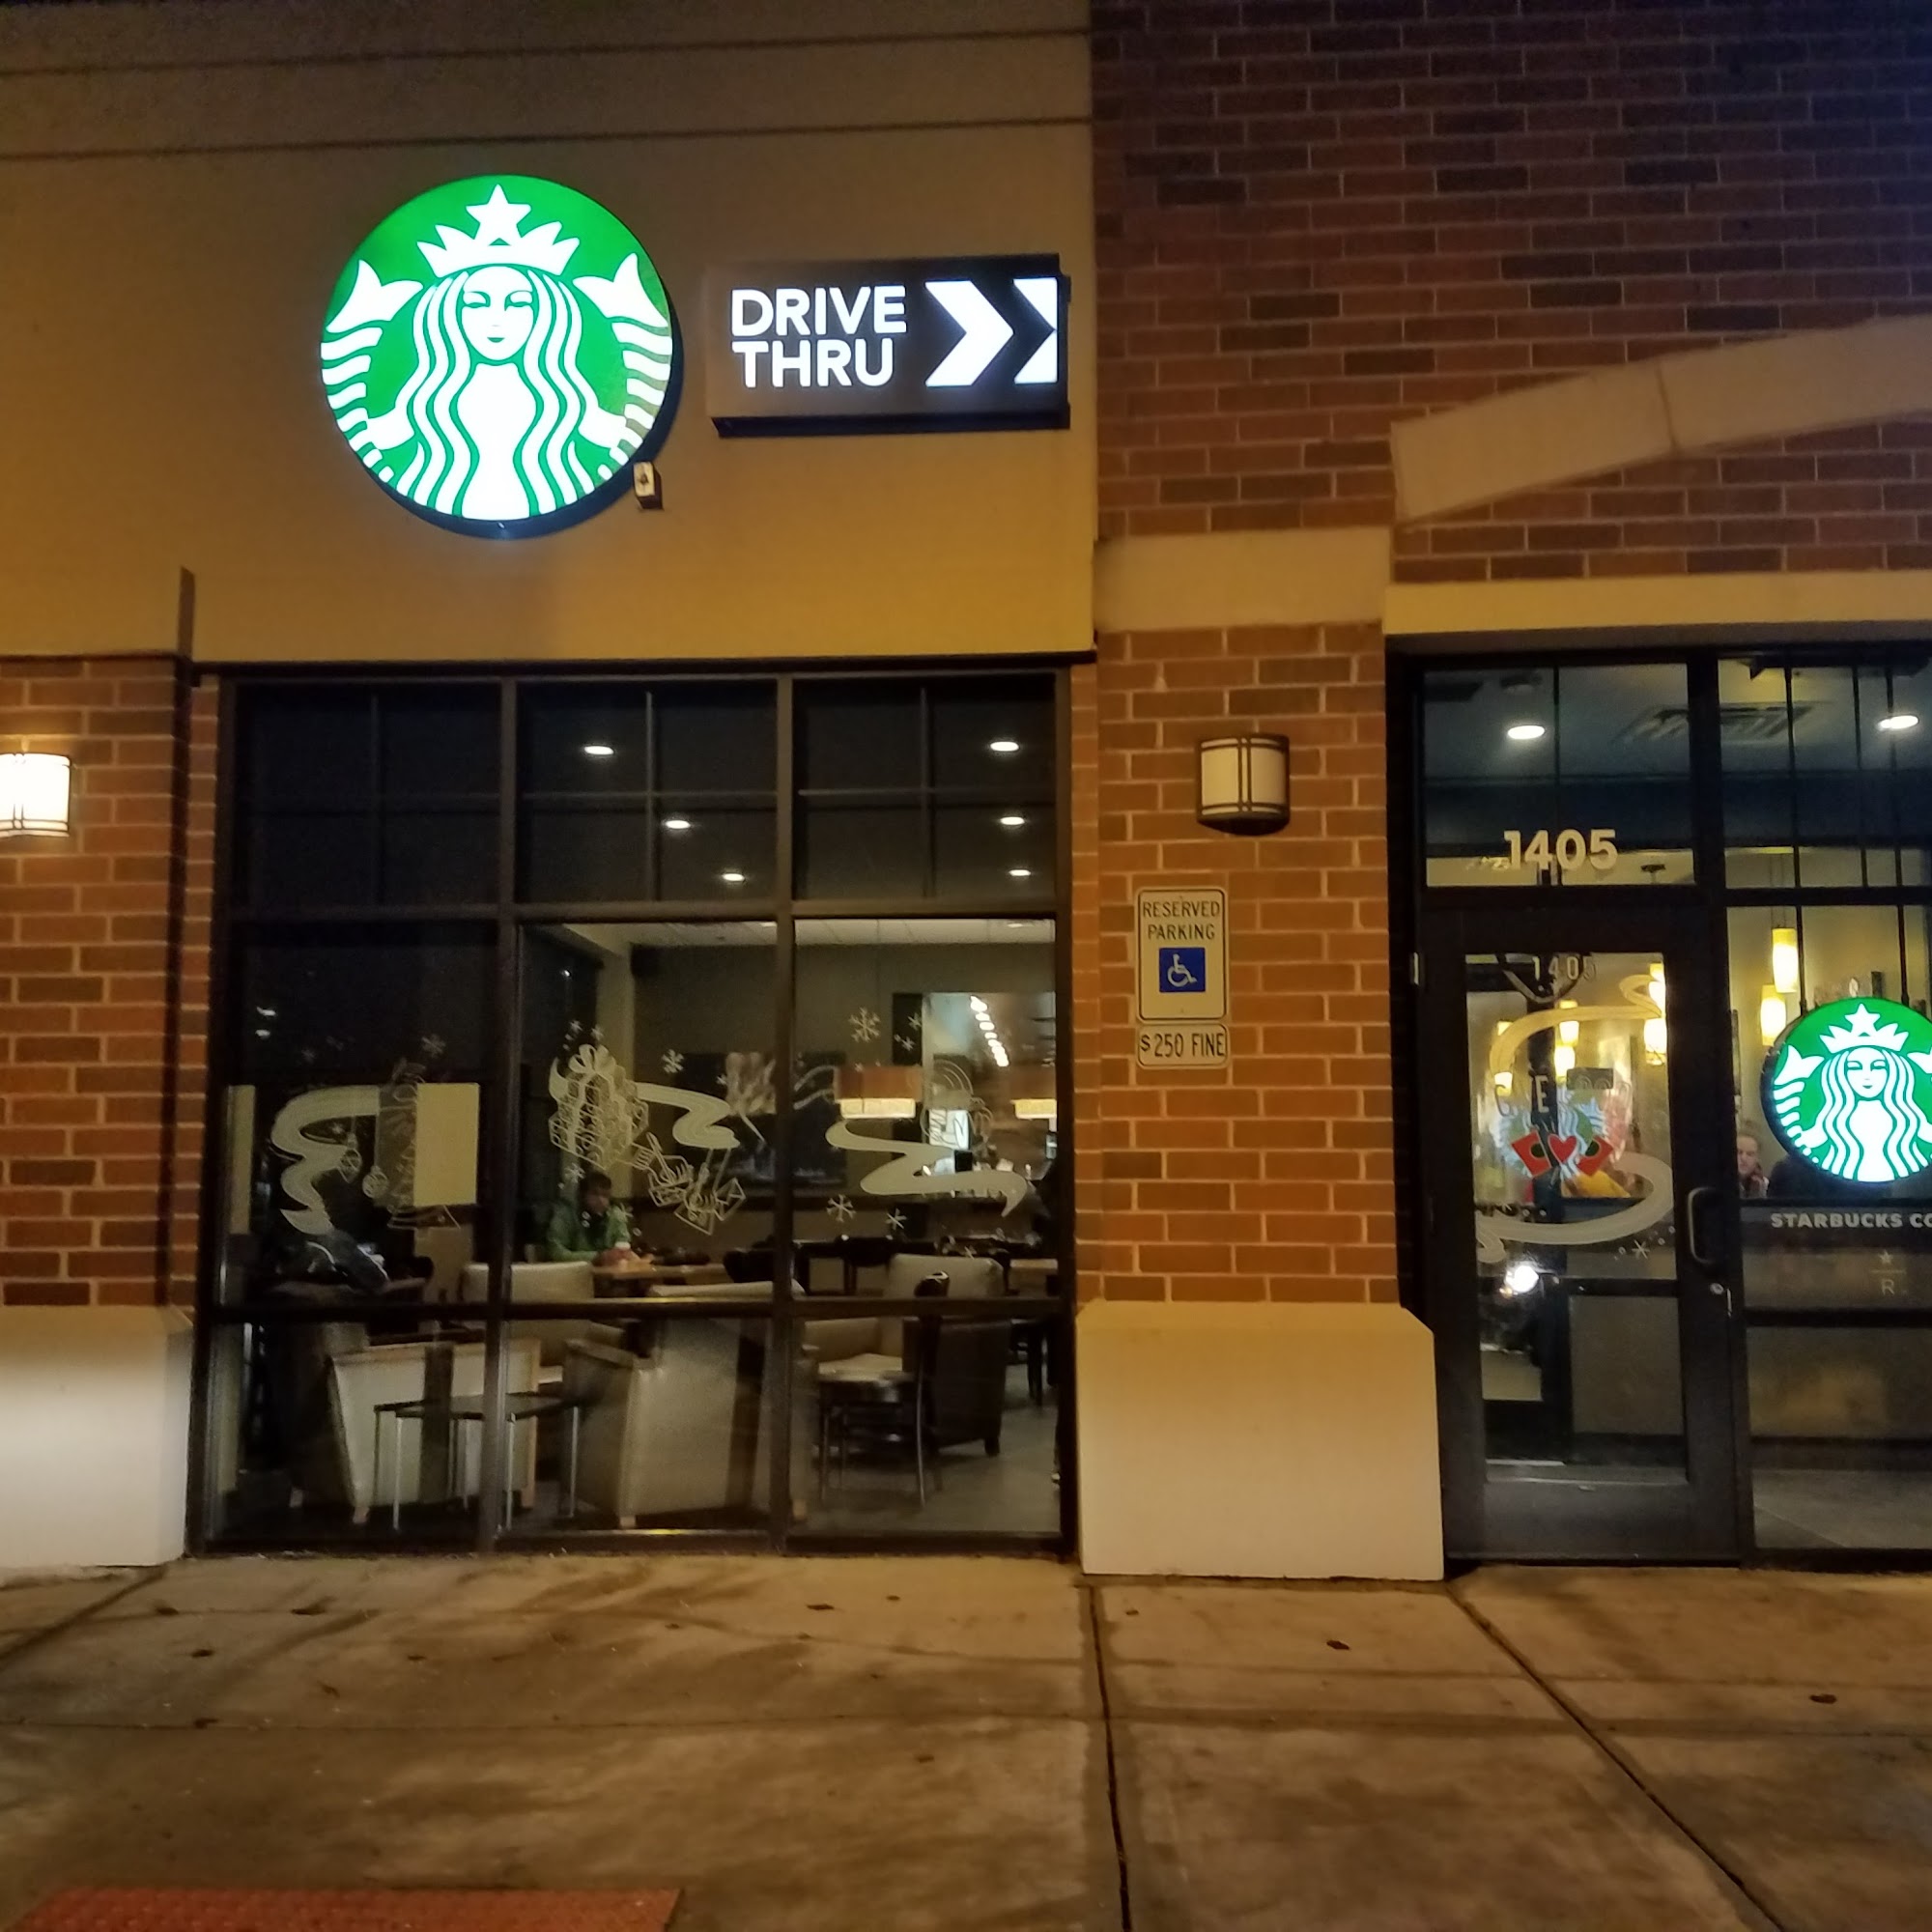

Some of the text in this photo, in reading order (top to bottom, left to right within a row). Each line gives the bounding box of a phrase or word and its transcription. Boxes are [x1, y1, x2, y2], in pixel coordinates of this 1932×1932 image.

[731, 285, 907, 337] DRIVE
[731, 338, 894, 387] THRU
[1503, 829, 1618, 870] 1405
[1143, 900, 1221, 918] RESERVED
[1148, 923, 1216, 940] PARKING
[1192, 1033, 1226, 1058] FINE
[1770, 1212, 1903, 1229] STARBUCKS
